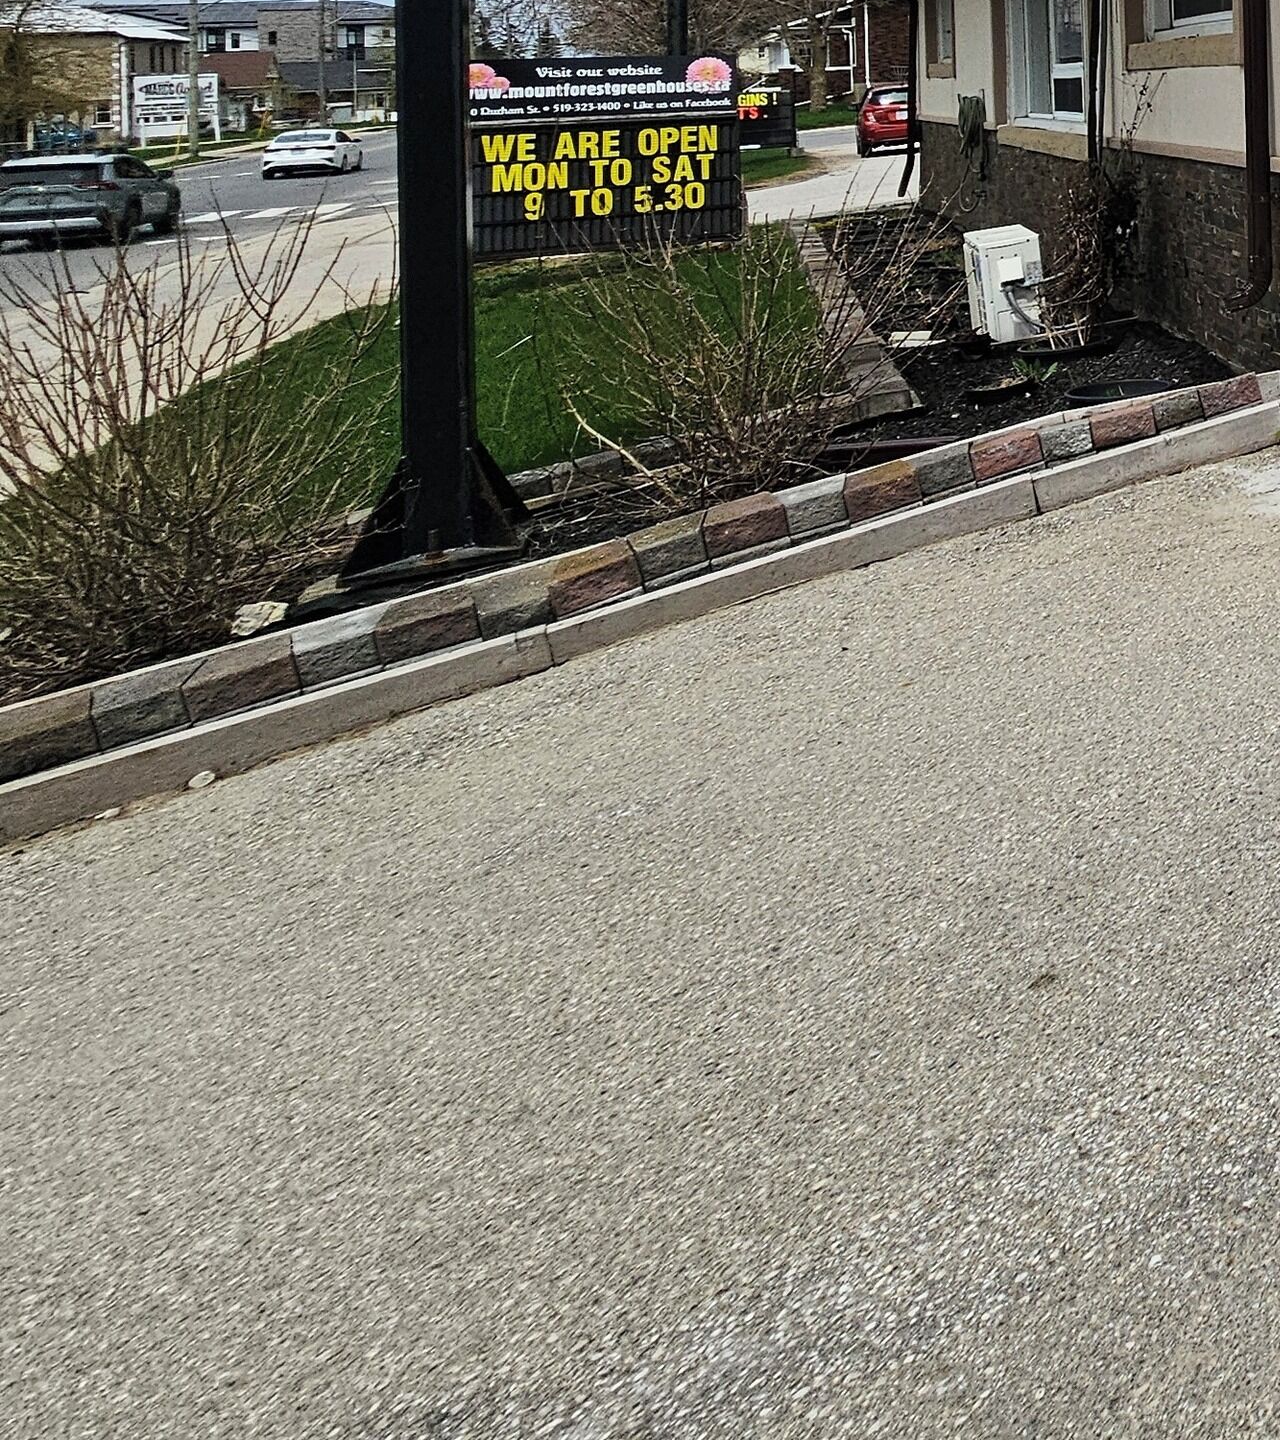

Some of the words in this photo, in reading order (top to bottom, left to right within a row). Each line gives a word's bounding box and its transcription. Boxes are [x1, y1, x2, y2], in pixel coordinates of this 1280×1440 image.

[535, 66, 572, 78] Visit
[576, 67, 604, 78] our
[606, 64, 664, 77] website
[480, 105, 525, 116] Durham
[526, 104, 542, 114] St.
[553, 101, 621, 113] 519-323-1400
[633, 100, 655, 110] Like
[669, 101, 684, 109] on
[685, 96, 732, 109] Facebook
[737, 92, 768, 107] GINS
[481, 133, 537, 162] WE
[554, 129, 621, 159] ARE
[637, 125, 718, 156] OPEN
[491, 161, 569, 193] MON
[589, 158, 633, 187] TO
[652, 153, 715, 184] SAT
[524, 191, 545, 221] 9
[569, 187, 613, 218] TO
[633, 182, 706, 213] 5.30
